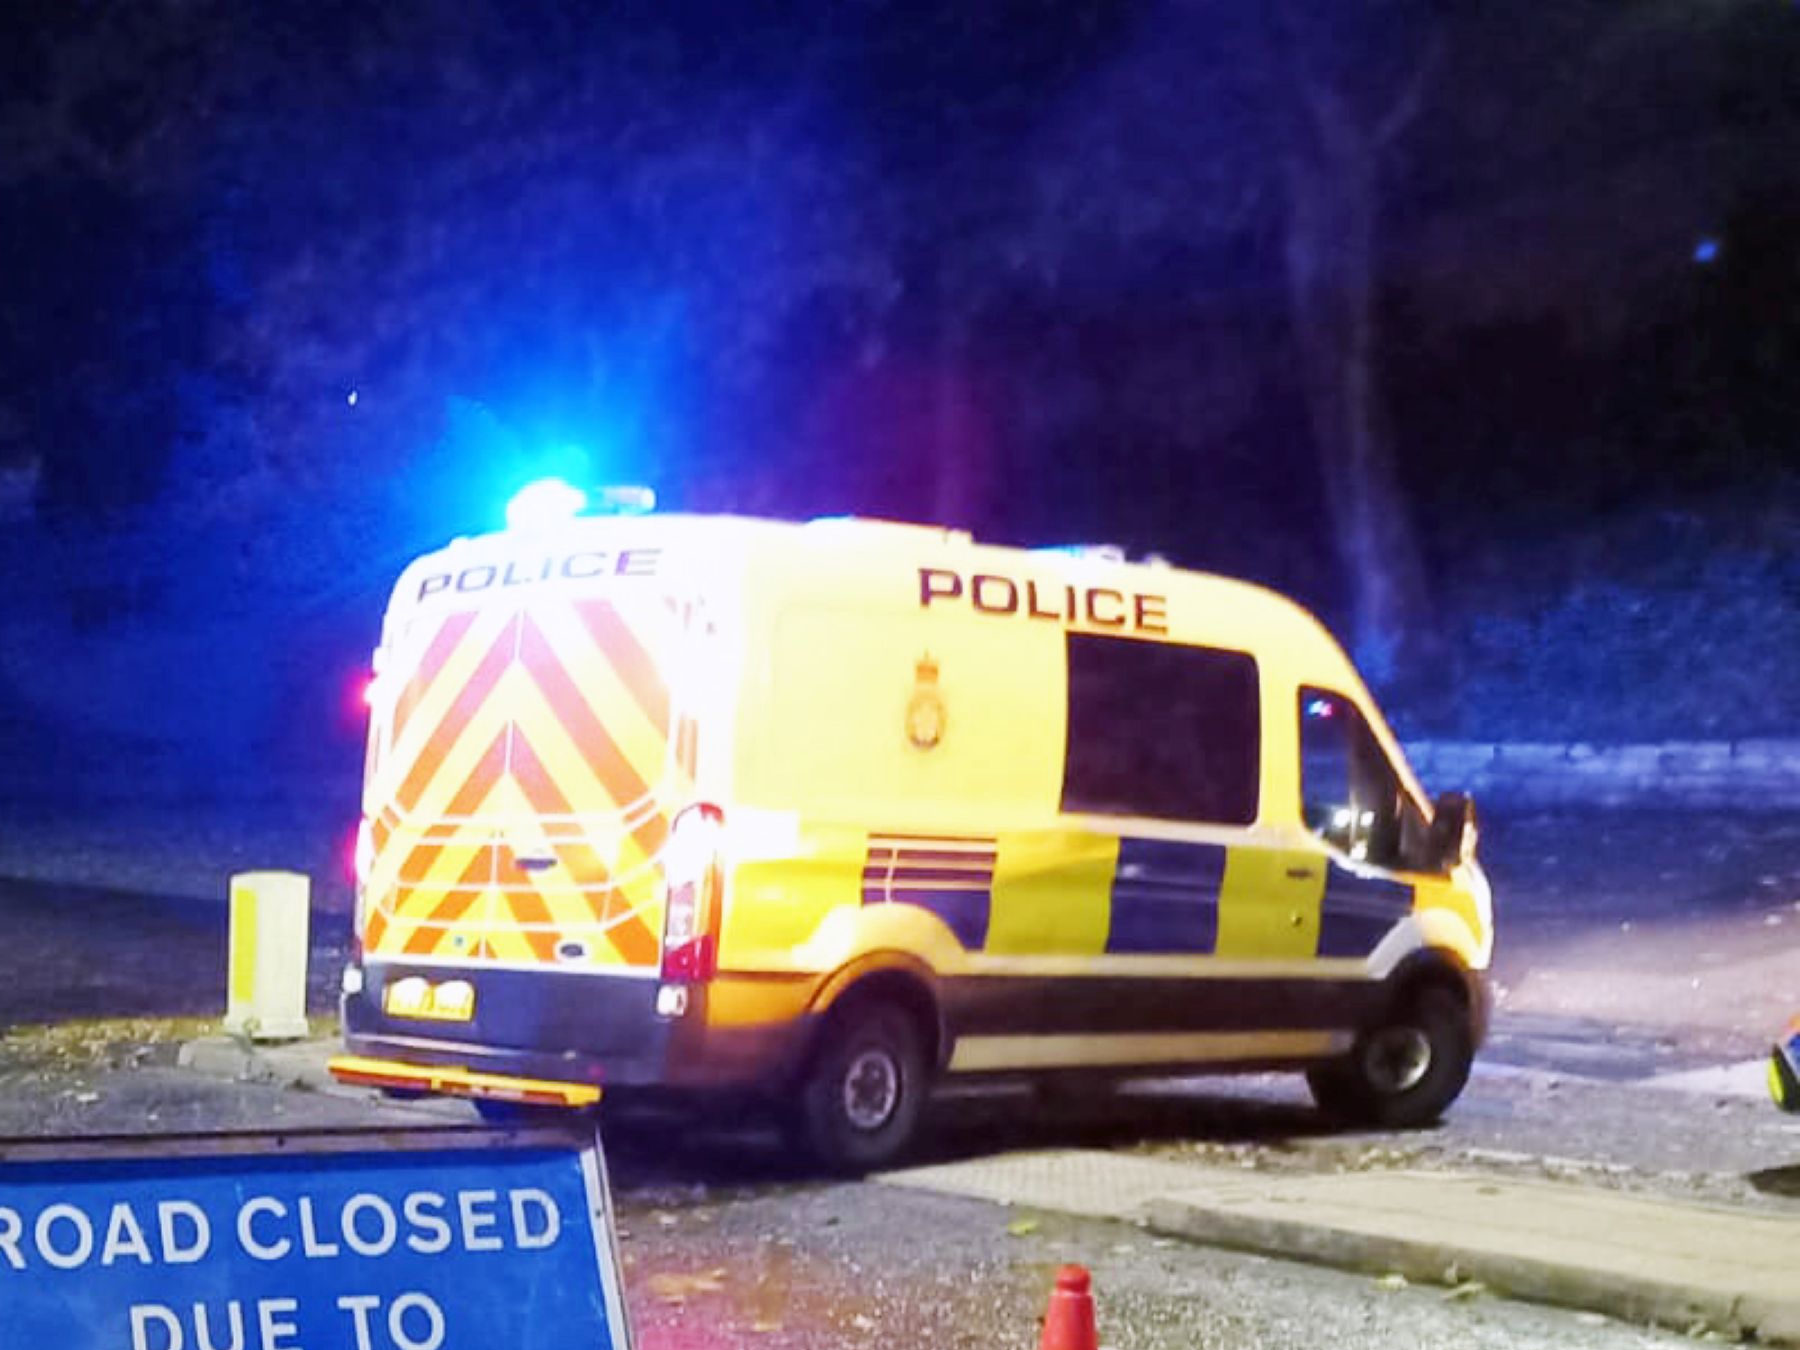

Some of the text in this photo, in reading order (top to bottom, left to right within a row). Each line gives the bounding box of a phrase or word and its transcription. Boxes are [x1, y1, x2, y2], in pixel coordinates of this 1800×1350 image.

[416, 548, 663, 603] POLICE
[917, 567, 1169, 635] POLICE
[237, 1188, 561, 1260] CLOSED
